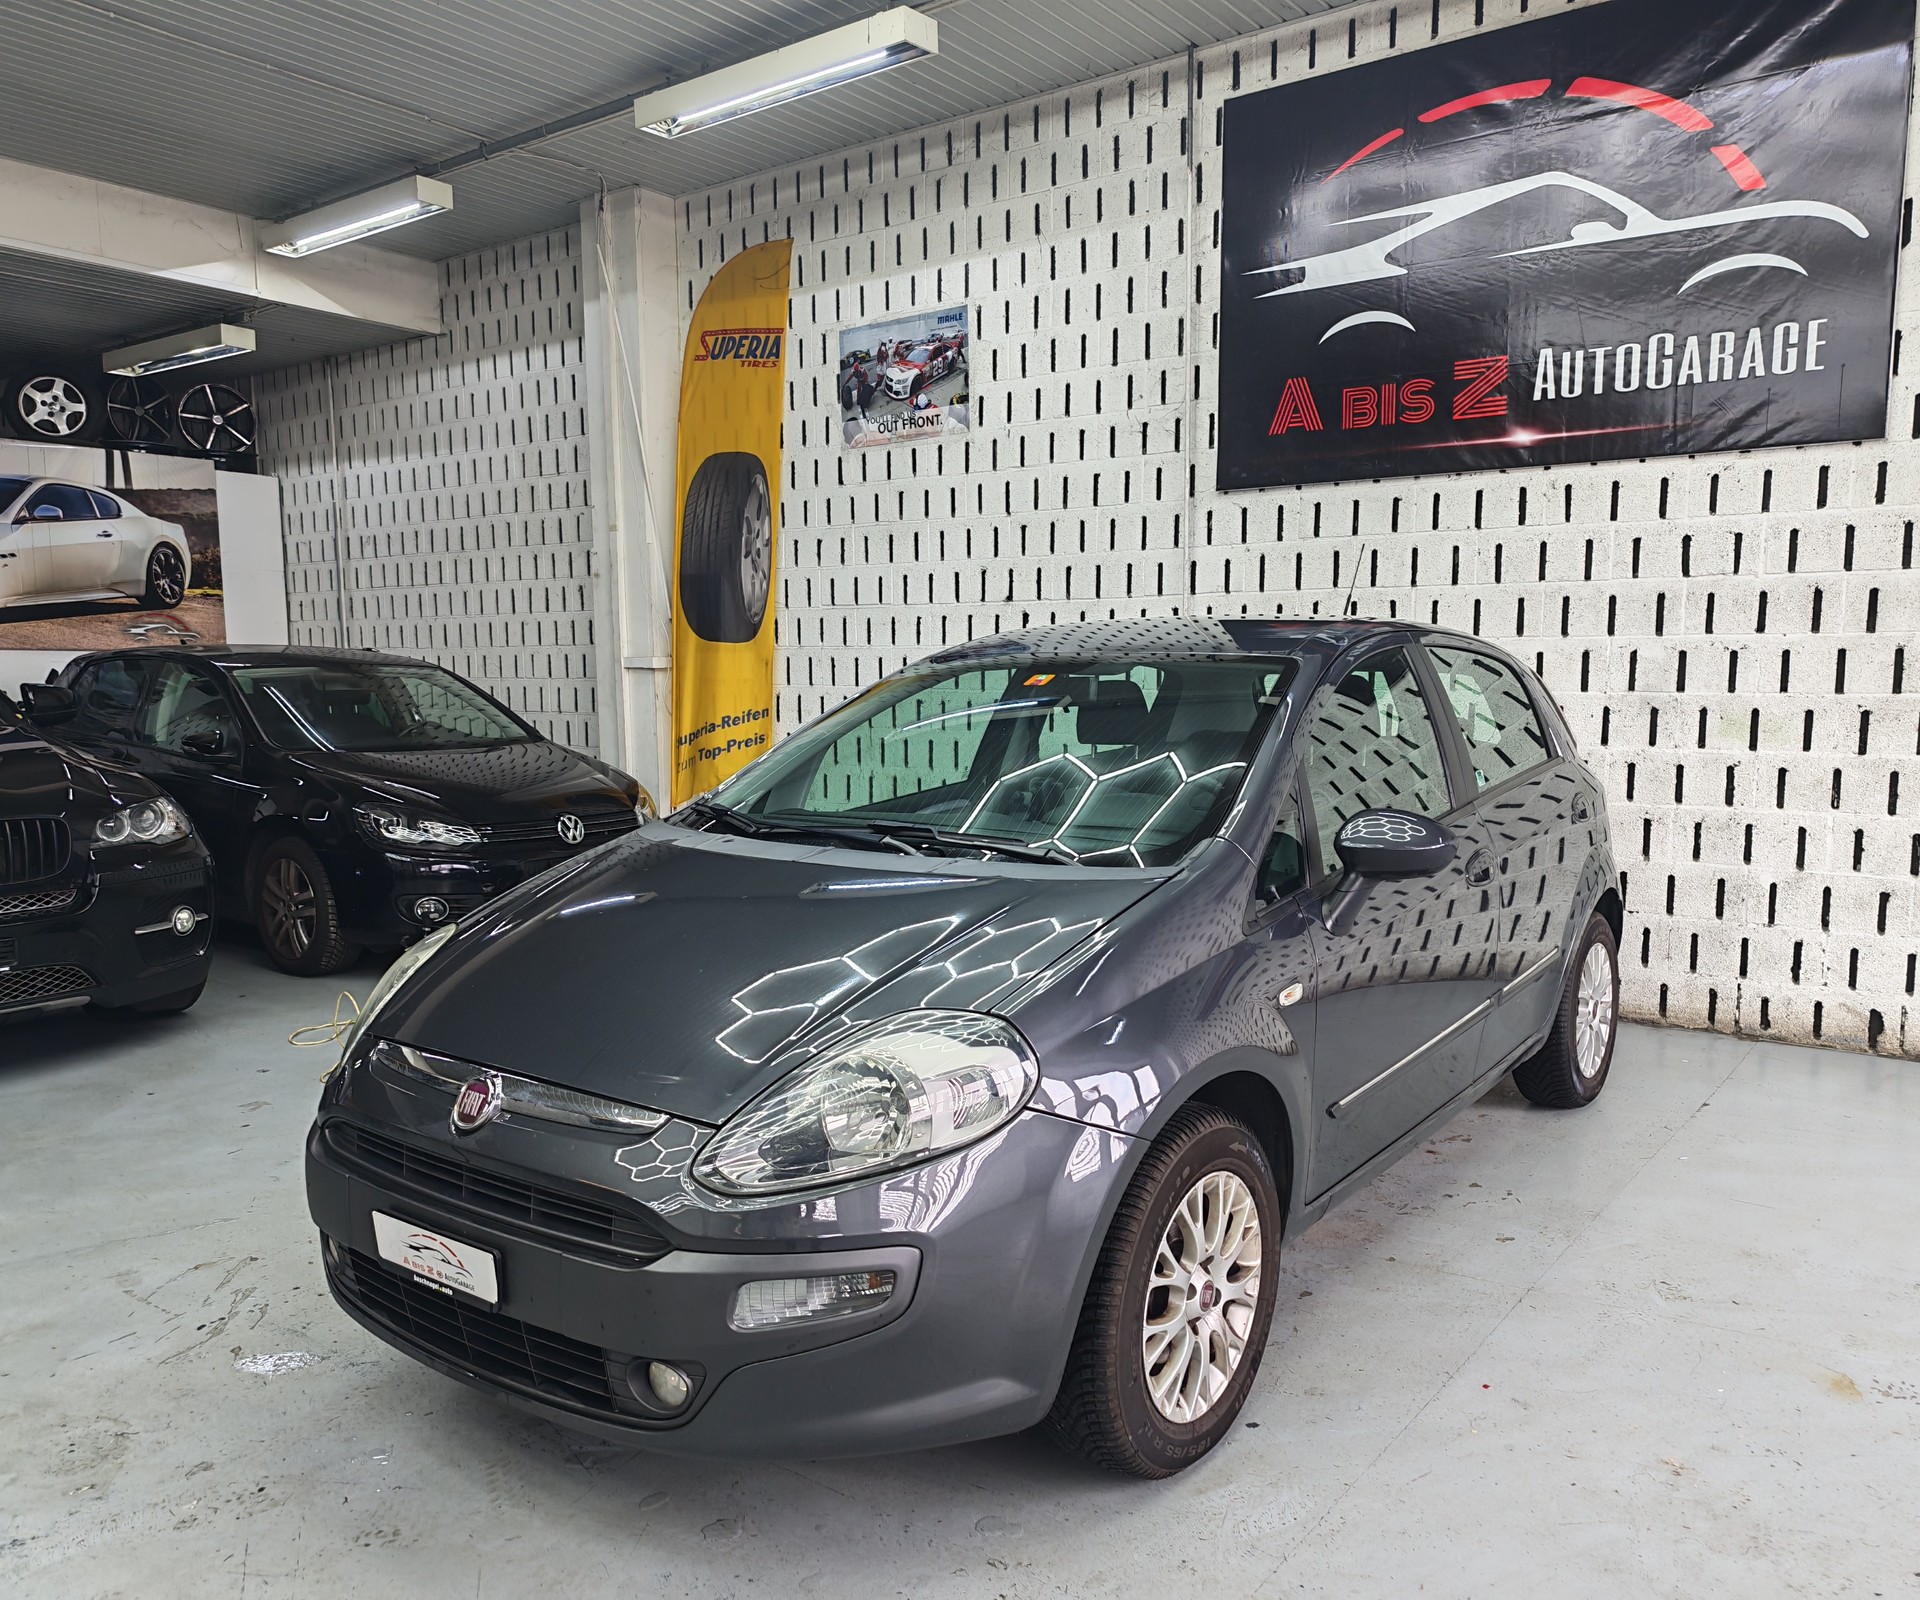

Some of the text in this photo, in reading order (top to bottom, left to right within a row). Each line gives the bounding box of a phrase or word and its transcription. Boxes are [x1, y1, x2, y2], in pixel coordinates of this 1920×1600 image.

[937, 313, 963, 325] MAHLE
[694, 327, 785, 362] SUPERIA
[740, 360, 779, 368] TIRES
[932, 357, 944, 377] 29
[1268, 377, 1324, 436] A
[1452, 355, 1508, 421] Z
[877, 413, 943, 434] OUT FRONT.
[698, 732, 766, 762] Top-Preis
[459, 1089, 487, 1117] FIAT
[403, 1256, 411, 1266] A
